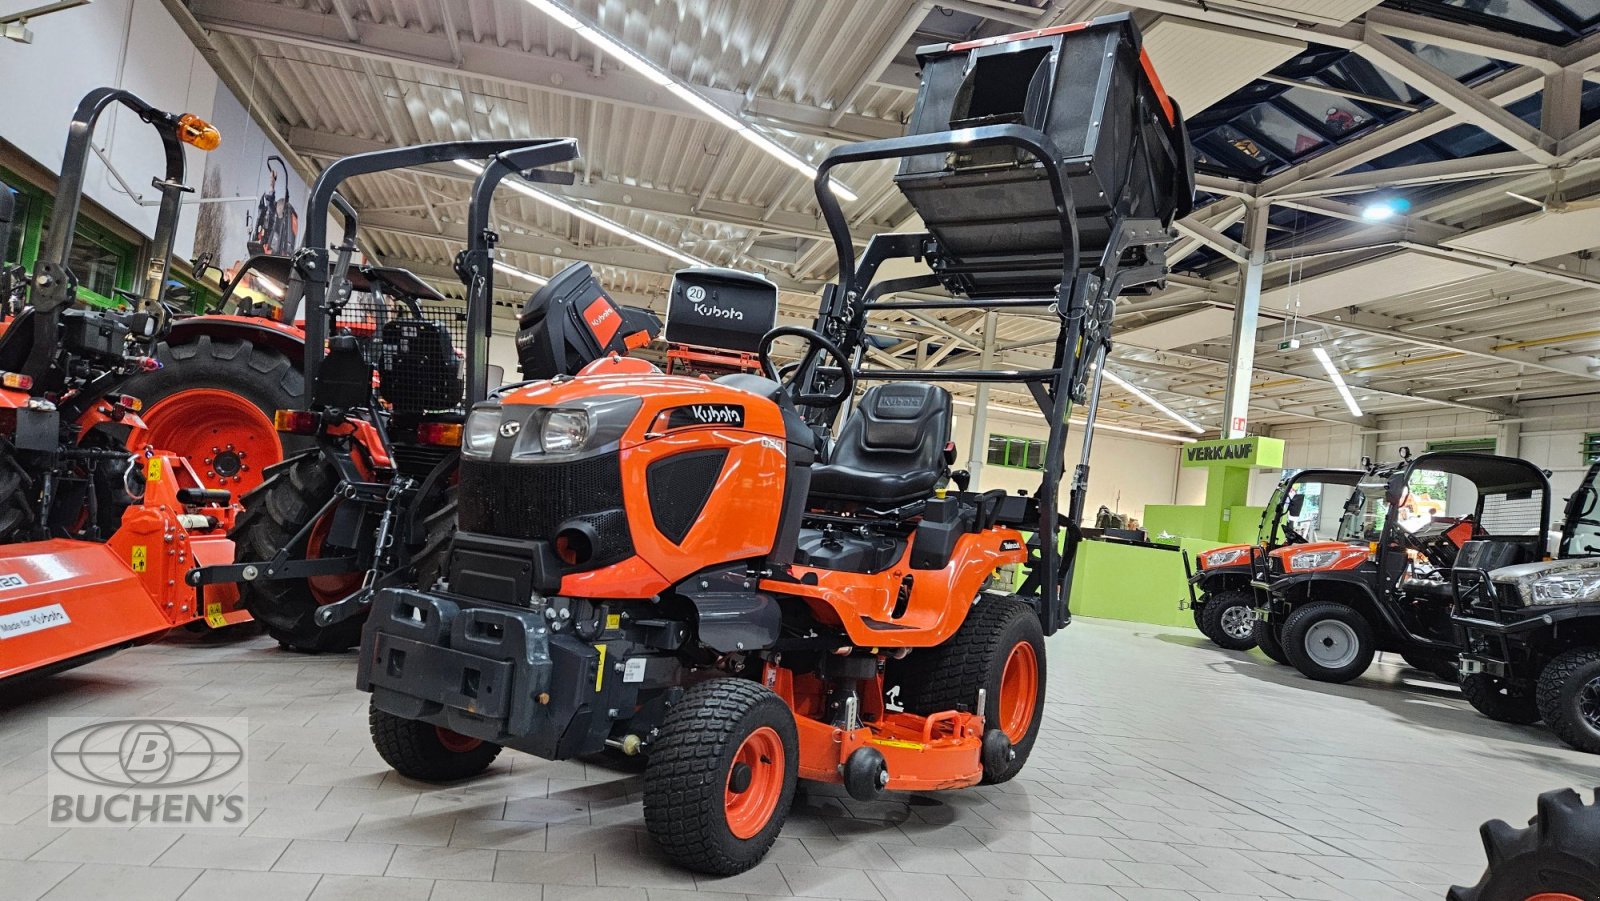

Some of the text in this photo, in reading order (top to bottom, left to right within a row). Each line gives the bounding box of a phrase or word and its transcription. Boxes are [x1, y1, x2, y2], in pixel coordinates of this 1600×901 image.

[689, 287, 703, 299] 20
[592, 308, 613, 326] Kubota
[694, 303, 743, 320] Kubota
[692, 405, 741, 422] Kubota
[1187, 443, 1253, 462] VERKAUF
[31, 609, 64, 625] Kubota
